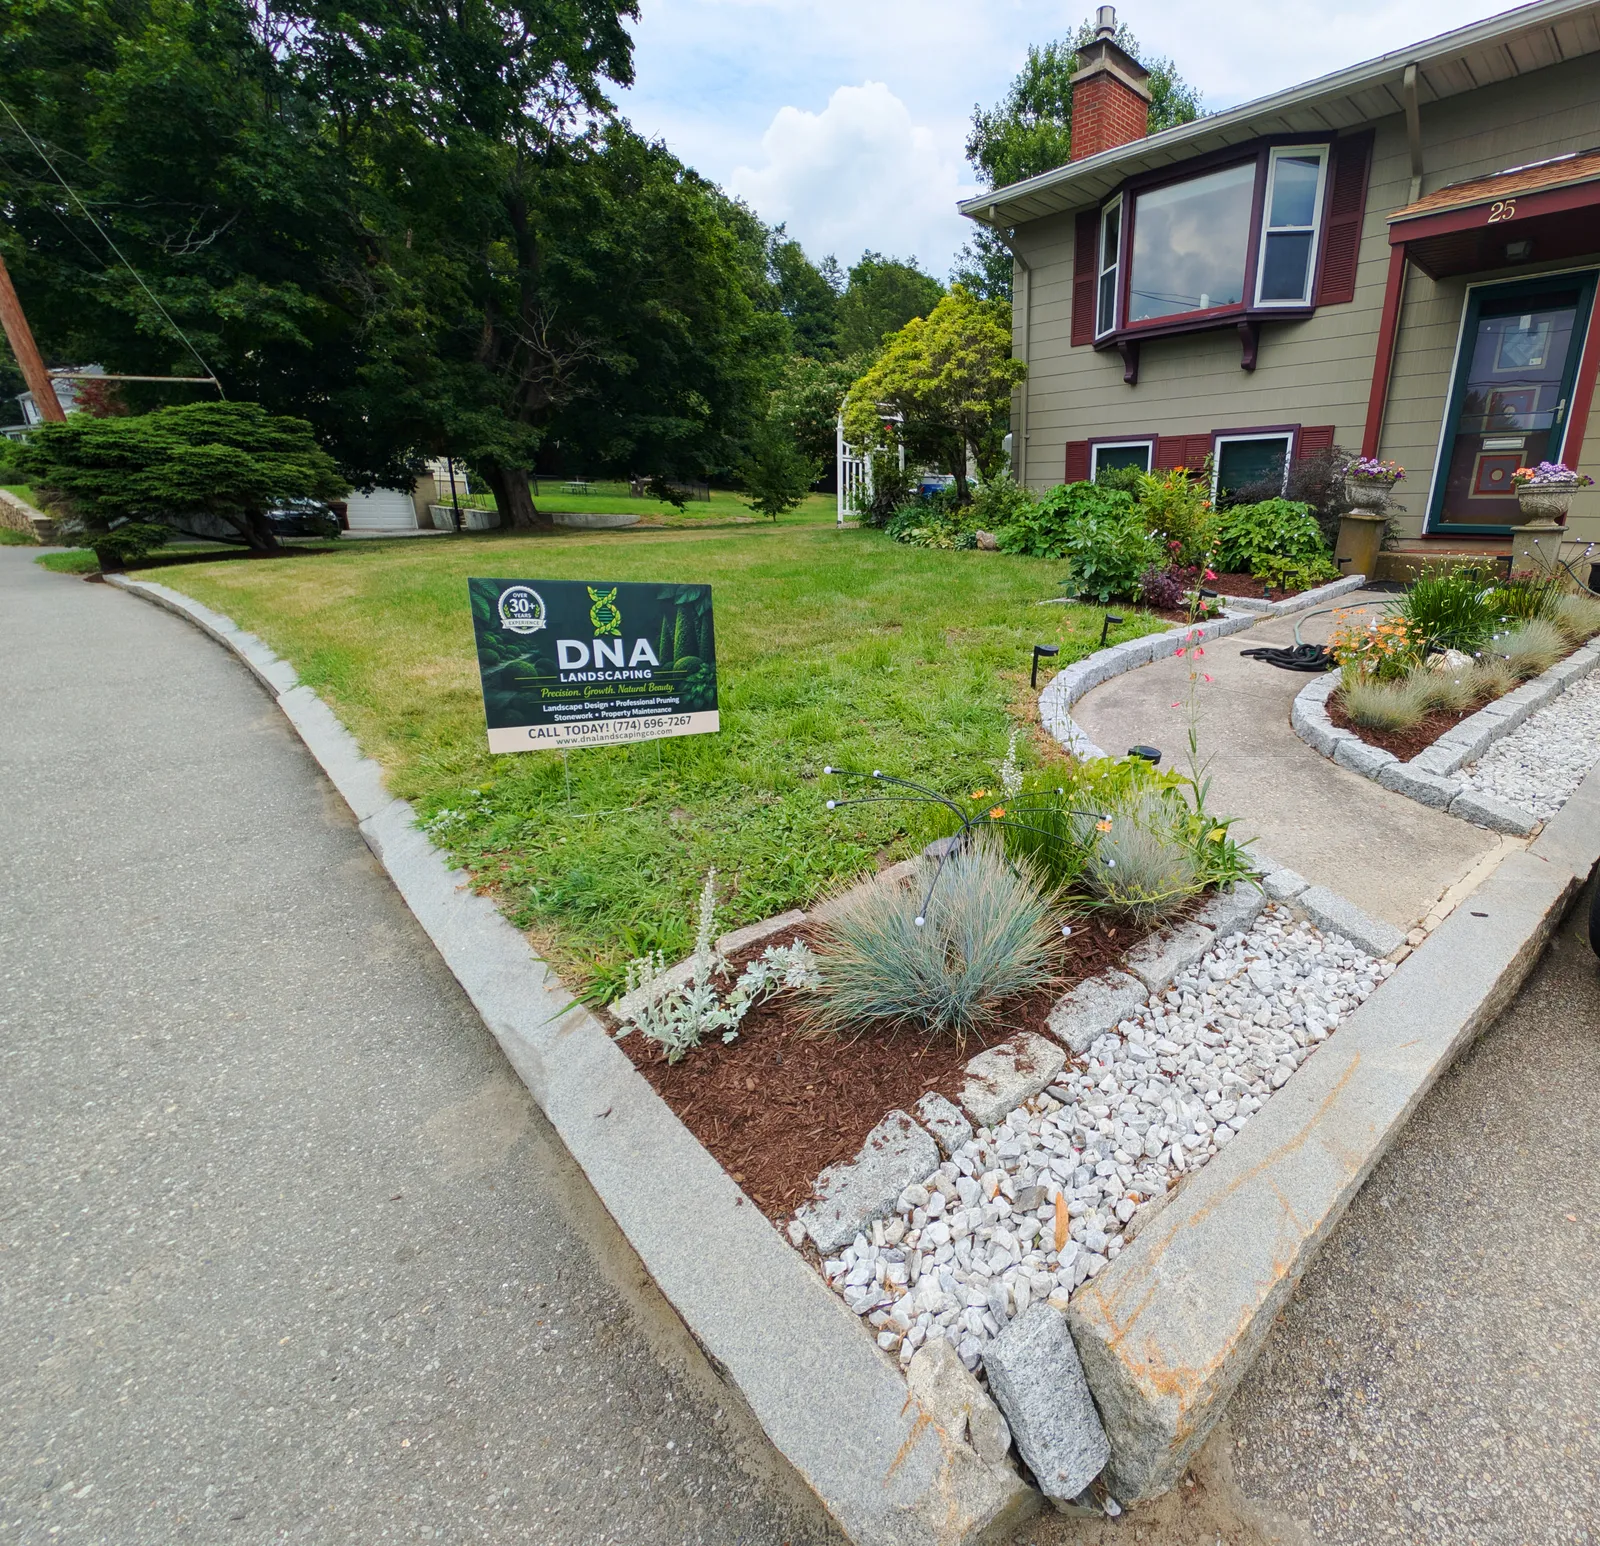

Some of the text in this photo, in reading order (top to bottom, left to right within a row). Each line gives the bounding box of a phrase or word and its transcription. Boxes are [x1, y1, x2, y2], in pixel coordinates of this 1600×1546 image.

[1488, 199, 1516, 224] 25
[510, 599, 535, 612] 30+
[556, 638, 659, 670] DNA
[560, 670, 652, 682] LANDSCAPING
[541, 682, 674, 698] Precision. Growth. Natural Beauty.
[543, 704, 582, 712] Landscape
[584, 702, 608, 710] Design
[616, 698, 655, 706] Professional
[554, 706, 672, 721] Stonework Property Maintenance
[528, 716, 691, 739] CALL TODAY! (774) 696-7267
[556, 728, 672, 744] www.dnalandscapingco.com
